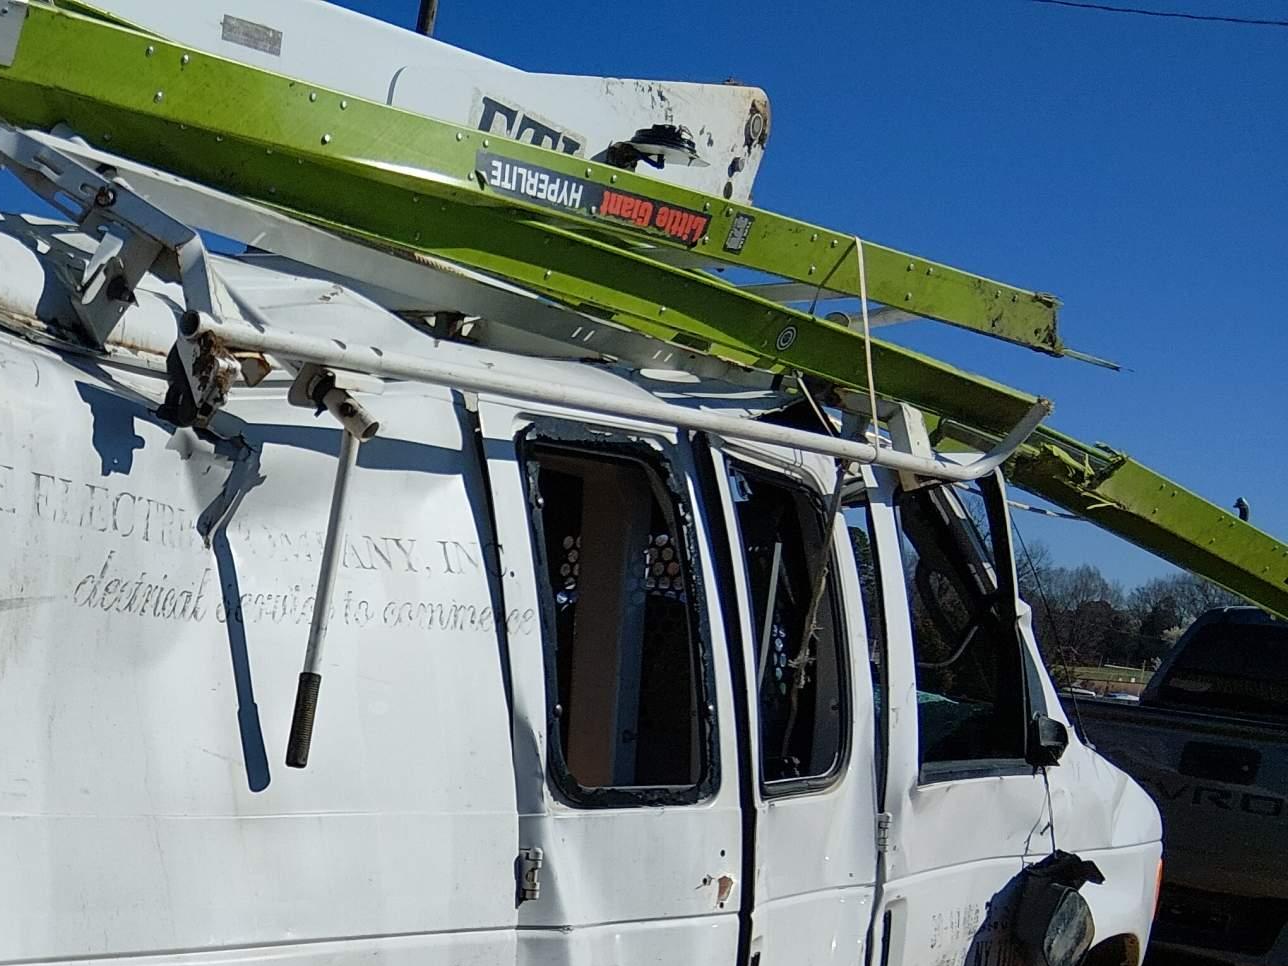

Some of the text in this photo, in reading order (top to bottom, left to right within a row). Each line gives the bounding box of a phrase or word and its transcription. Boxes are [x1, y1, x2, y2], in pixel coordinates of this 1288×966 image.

[489, 160, 585, 210] HYPERLITE
[599, 190, 653, 228] Giant
[657, 206, 708, 244] Little
